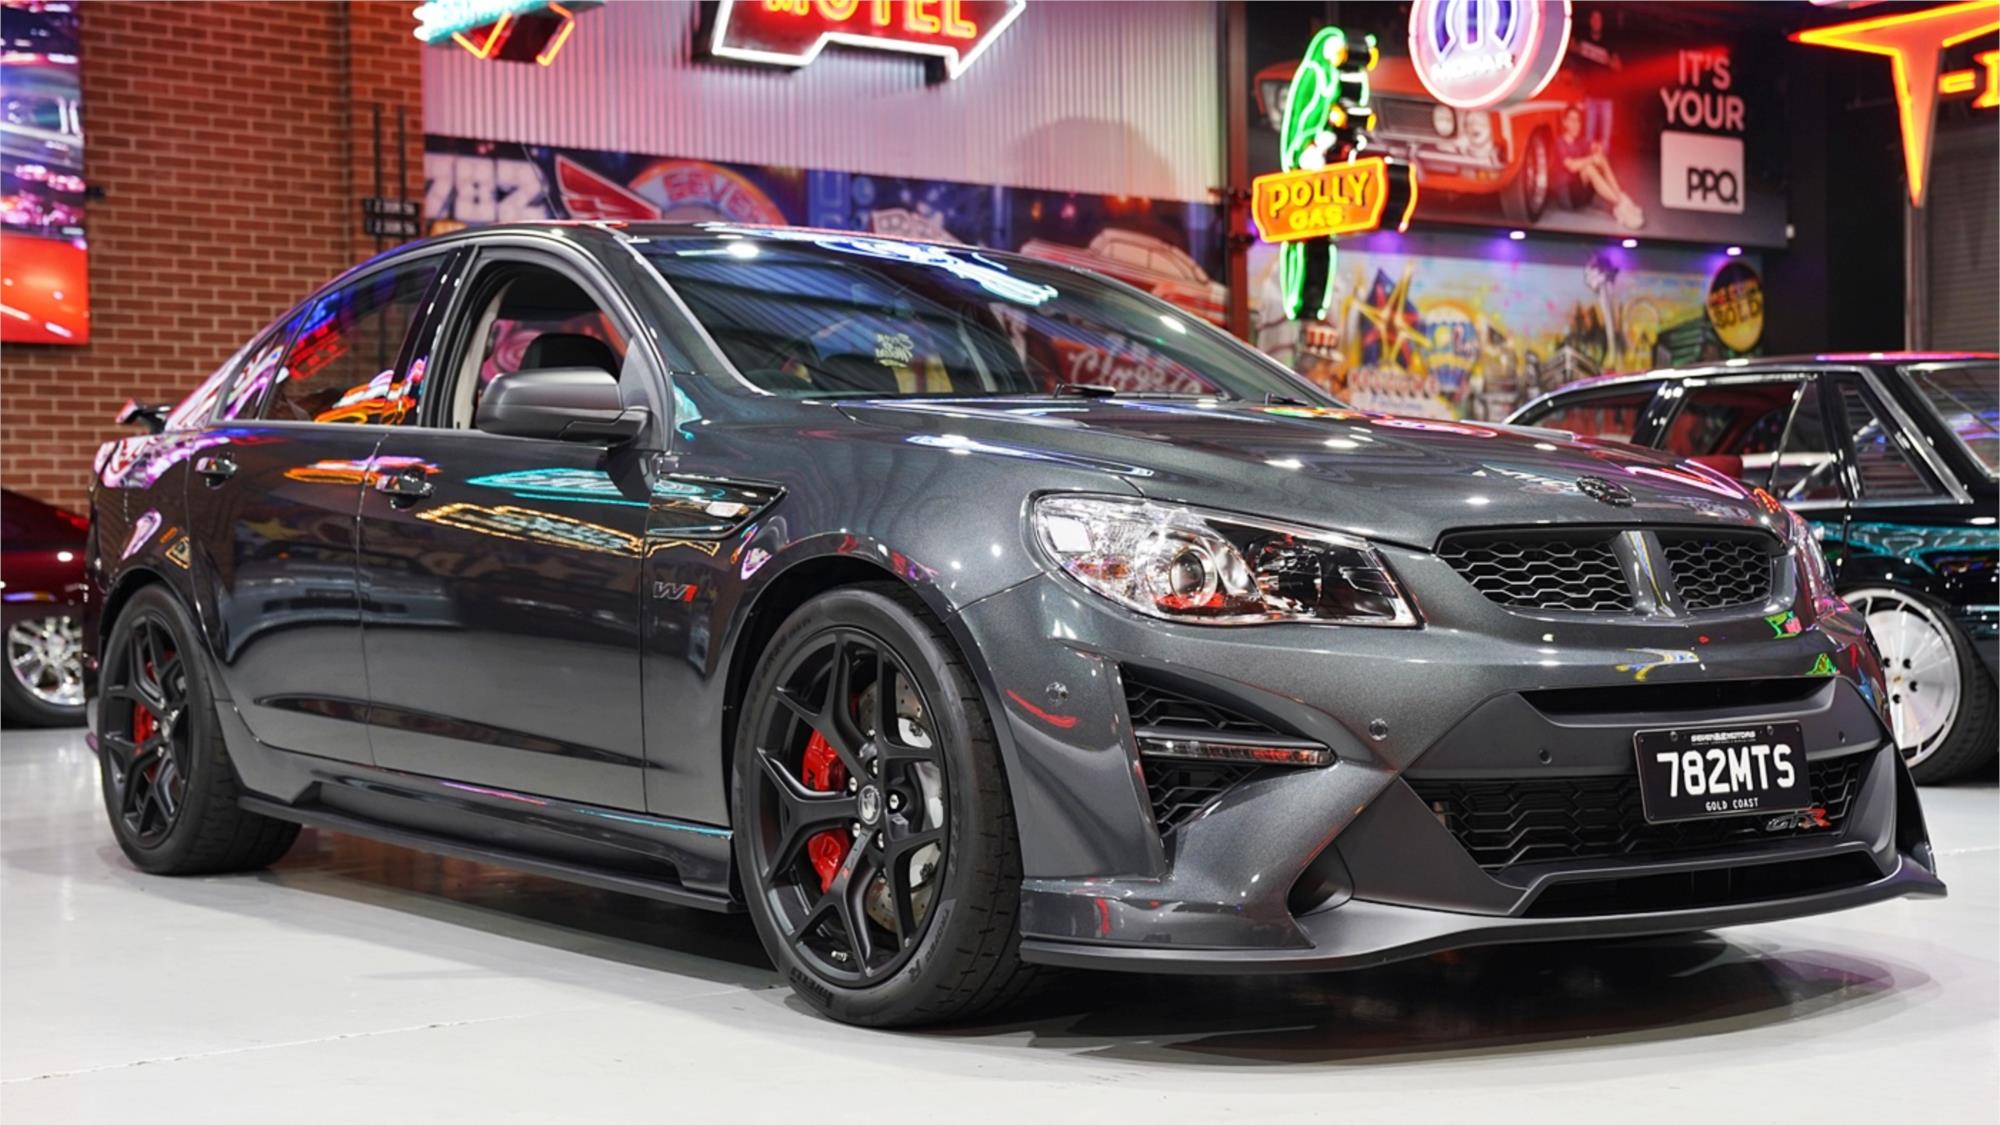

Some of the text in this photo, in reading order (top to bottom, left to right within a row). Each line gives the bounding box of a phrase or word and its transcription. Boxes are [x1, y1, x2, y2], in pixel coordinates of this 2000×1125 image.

[1679, 49, 1731, 90] IT'S
[1660, 87, 1745, 131] YOUR
[1268, 171, 1369, 218] POLLY
[1686, 167, 1738, 205] PPQ
[1289, 204, 1343, 231] GAS
[1656, 744, 1796, 798] 782MTS
[1705, 797, 1759, 812] GOLD COAST
